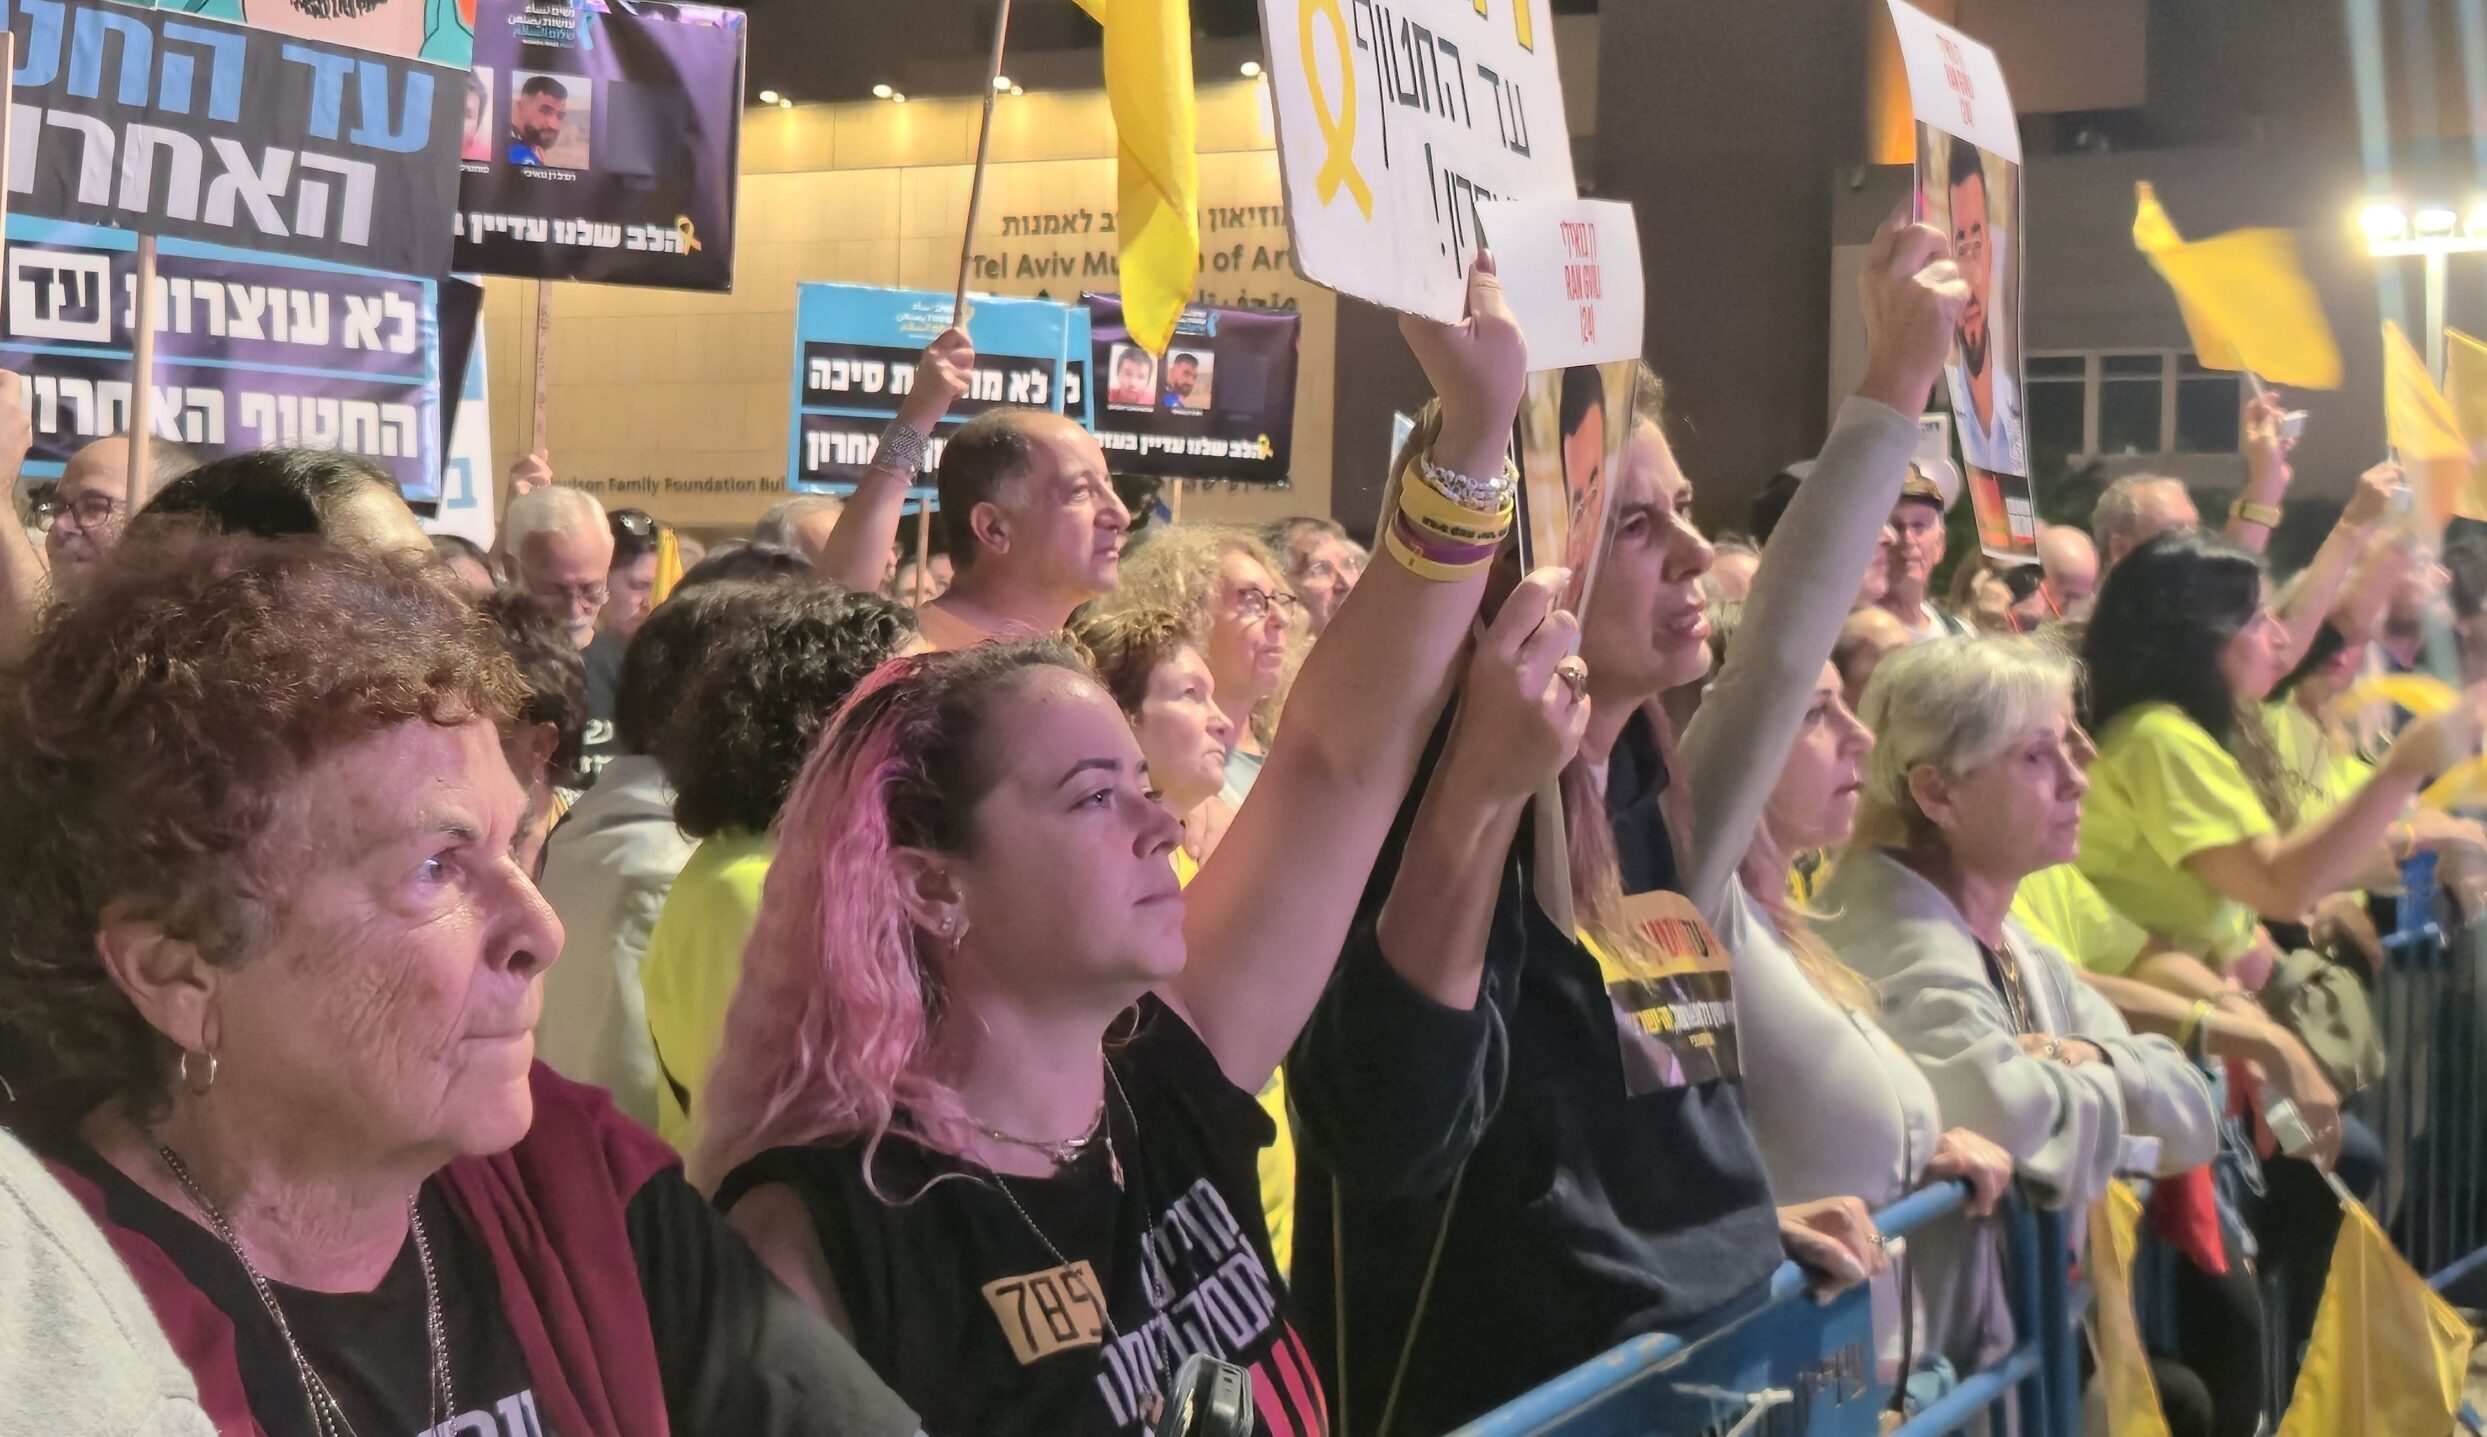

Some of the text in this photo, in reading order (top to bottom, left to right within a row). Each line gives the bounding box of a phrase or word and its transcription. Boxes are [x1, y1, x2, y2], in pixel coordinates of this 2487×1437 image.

[282, 44, 434, 153] עד
[1477, 64, 1530, 158] עד
[8, 103, 376, 247] האחרו
[471, 213, 548, 244] עדיין
[555, 217, 621, 247] שלנו
[1002, 208, 1093, 236] לאמנות
[1208, 206, 1284, 232] וזיאון
[974, 252, 1008, 279] Tel
[1016, 251, 1075, 279] Aviv
[1213, 244, 1244, 272] of
[1251, 246, 1289, 271] Ar
[19, 265, 416, 354] לא עוצרות עד
[809, 356, 885, 393] סיבה
[1009, 369, 1048, 404] לא
[240, 391, 417, 459] החטוף
[1140, 434, 1186, 455] עדיין
[1187, 436, 1228, 457] שלנו
[608, 477, 660, 496] Family
[665, 476, 755, 492] Foundation
